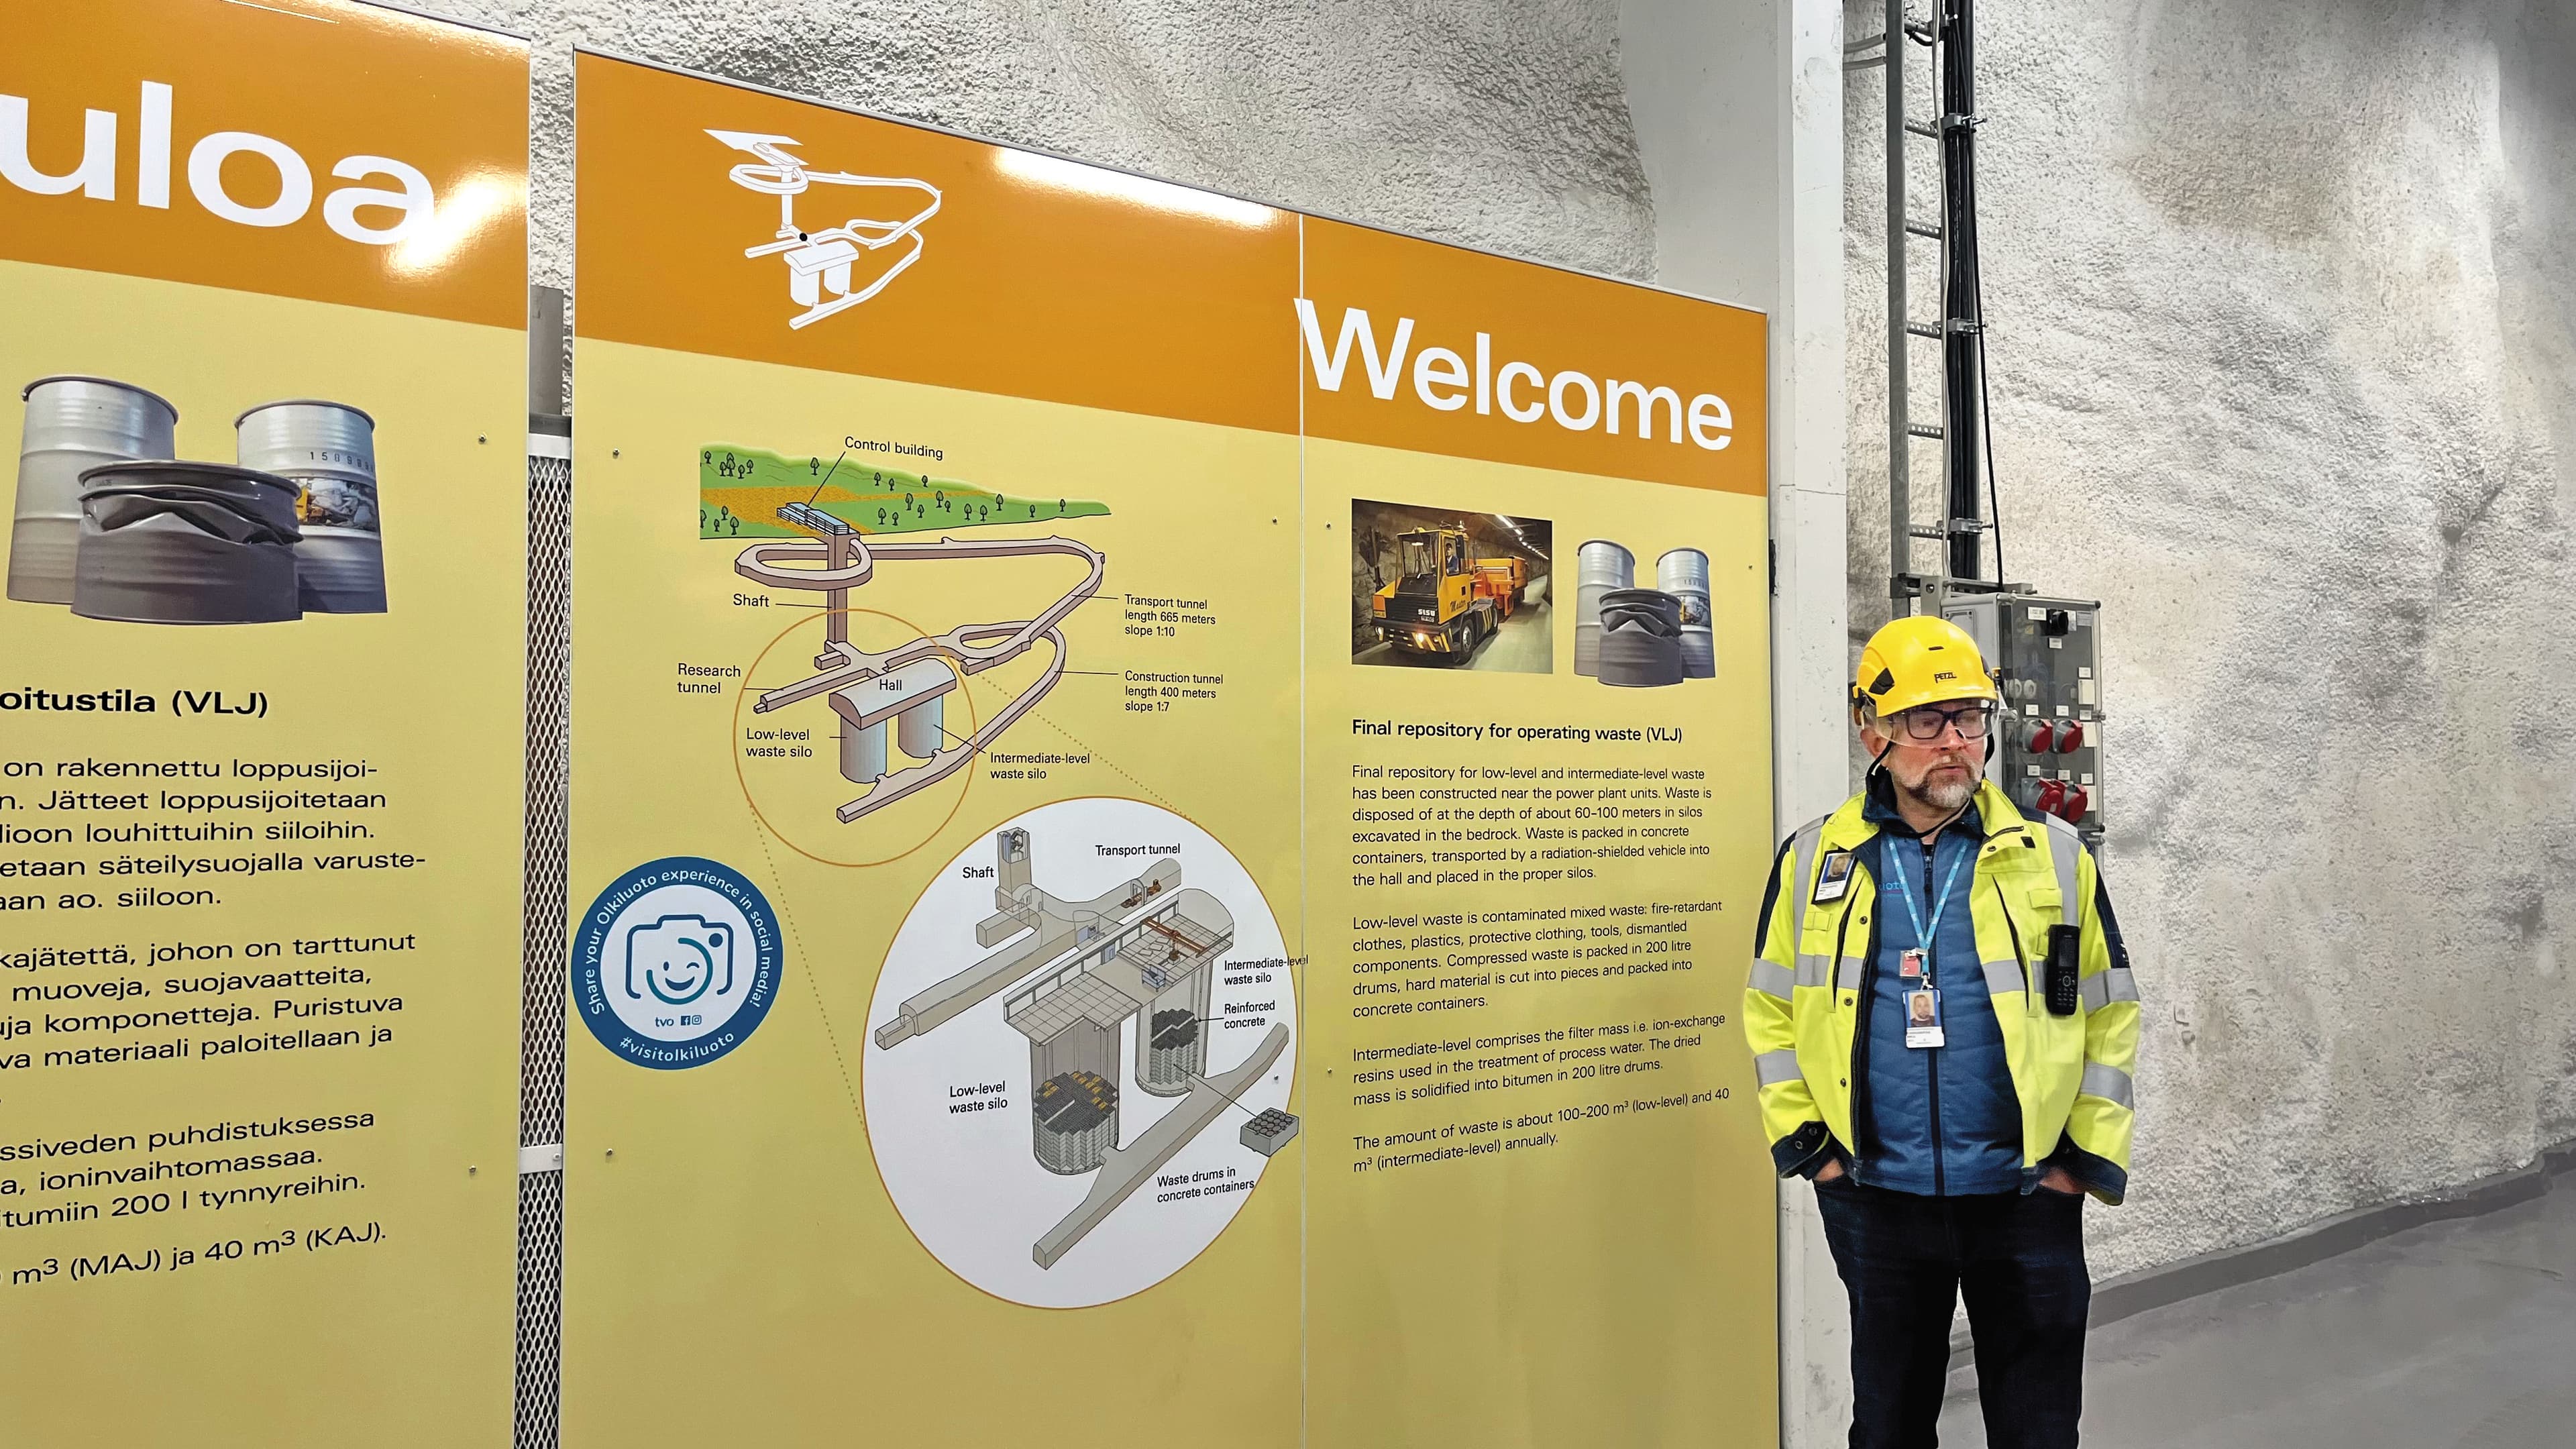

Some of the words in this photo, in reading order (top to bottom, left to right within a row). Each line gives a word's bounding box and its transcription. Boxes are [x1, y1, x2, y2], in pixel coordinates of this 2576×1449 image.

[1293, 297, 1733, 451] Welcome
[845, 436, 890, 452] Control
[896, 442, 943, 461] building
[733, 594, 769, 607] Shaft
[1124, 594, 1174, 608] Transport
[1177, 599, 1207, 609] tunnel
[1126, 609, 1157, 623] length
[1161, 612, 1178, 622] 665
[1182, 615, 1216, 625] meters
[1125, 625, 1152, 637] slope
[1157, 626, 1175, 637] 1:10
[678, 663, 741, 677] Research
[1126, 670, 1189, 683] Construction
[1193, 674, 1223, 684] tunnel
[1934, 672, 1957, 684] PETZL
[677, 682, 720, 694] tunnel
[879, 679, 902, 691] Hall
[1126, 686, 1157, 698] length
[1161, 687, 1179, 697] 400
[1183, 689, 1216, 698] meters
[0, 687, 155, 712] oitustila
[172, 690, 267, 718] (VLJ)
[1126, 700, 1152, 713] slope
[1157, 702, 1169, 711] 1:7
[747, 728, 809, 740] Low-level
[1353, 719, 1391, 735] Final
[1398, 722, 1483, 741] repository
[1489, 723, 1512, 737] for
[1517, 725, 1590, 743] operating
[1595, 728, 1642, 741] waste
[1647, 727, 1682, 743] (VLJ)
[746, 747, 786, 757] waste
[790, 745, 812, 757] silo
[991, 752, 1089, 763] Intermediate-level
[4, 763, 42, 777] on
[58, 758, 219, 777] rakennettu
[233, 759, 377, 782] loppusijoi-
[991, 769, 1024, 779] waste
[1028, 768, 1046, 779] silo
[1353, 765, 1383, 777] Final
[1389, 765, 1455, 781] repository
[1459, 766, 1477, 778] for
[1483, 767, 1536, 778] low-level
[1542, 767, 1563, 779] and
[1568, 767, 1667, 779] intermediate-level
[1672, 770, 1704, 779] waste
[38, 790, 148, 810] Jätteet
[161, 790, 385, 813] loppusijoitetaan
[1353, 787, 1377, 799] has
[1383, 787, 1414, 799] been
[1420, 787, 1497, 799] constructed
[1502, 790, 1528, 799] near
[1532, 787, 1552, 798] the
[1556, 790, 1594, 801] power
[1599, 787, 1626, 801] plant
[1631, 787, 1660, 798] units.
[1665, 787, 1699, 798] Waste
[1703, 790, 1711, 798] is
[87, 822, 252, 842] louhittuihin
[266, 821, 374, 839] siiloihin.
[1095, 845, 1146, 857] Transport
[1148, 843, 1180, 854] tunnel
[0, 859, 85, 877] etaan
[99, 853, 302, 877] säteilysuojalla
[314, 853, 425, 869] varuste-
[963, 866, 994, 878] Shaft
[661, 869, 740, 898] experience
[58, 894, 102, 908] ao.
[117, 888, 220, 907] siiloon.
[597, 874, 657, 924] Olkiluoto
[739, 894, 753, 910] in
[1354, 914, 1417, 929] Low-level
[1423, 914, 1462, 926] waste
[1468, 911, 1477, 923] is
[1483, 907, 1566, 922] contaminated
[1571, 905, 1605, 918] mixed
[1609, 905, 1647, 916] waste:
[1652, 900, 1722, 914] fire-retardant
[751, 911, 773, 952] social
[1353, 937, 1405, 951] clothes,
[1411, 934, 1464, 951] plastics,
[1470, 930, 1531, 947] protective
[1536, 927, 1586, 941] clothing,
[1591, 924, 1621, 936] tools,
[1627, 920, 1686, 934] dismantled
[147, 943, 232, 967] johon
[245, 943, 280, 957] on
[292, 934, 415, 955] tarttunut
[586, 928, 604, 965] your
[13, 977, 150, 1002] muoveja,
[164, 966, 371, 995] suojavaatteita,
[749, 955, 771, 1008] media!
[1224, 975, 1252, 985] waste
[1256, 972, 1271, 983] silo
[586, 969, 604, 1015] Share
[1225, 1000, 1275, 1014] Reinforced
[1354, 1002, 1412, 1017] concrete
[1417, 996, 1488, 1012] containers.
[0, 1016, 31, 1040] ja
[46, 1003, 259, 1034] komponetteja.
[274, 998, 402, 1018] Puristuva
[655, 1016, 674, 1027] tvo
[1224, 1017, 1265, 1029] concrete
[45, 1038, 188, 1066] materiaali
[202, 1030, 359, 1060] paloitellaan
[368, 1025, 391, 1046] ja
[619, 1032, 735, 1062] #visitolkiluoto
[1354, 1037, 1470, 1061] Intermediate-level
[1476, 1032, 1540, 1049] comprises
[1544, 1029, 1564, 1041] the
[1568, 1026, 1594, 1039] filter
[1599, 1025, 1629, 1036] mass
[1633, 1021, 1648, 1032] i.e.
[1654, 1015, 1725, 1030] ion-exchange
[950, 1081, 1005, 1097] Low-level
[949, 1101, 984, 1114] waste
[988, 1097, 1008, 1109] silo
[149, 1114, 374, 1152] puhdistuksessa
[1378, 1139, 1500, 1171] (intermediate-level)
[1505, 1132, 1558, 1150] annually.
[1, 1180, 25, 1195] a,
[40, 1150, 321, 1191] ioninvaihtomassaa.
[1157, 1175, 1189, 1187] Waste
[1192, 1171, 1224, 1182] drums
[1227, 1167, 1235, 1177] in
[0, 1201, 97, 1227] tumiin
[111, 1193, 170, 1216] 200
[199, 1174, 364, 1210] tynnyreihin.
[1157, 1188, 1201, 1203] concrete
[1204, 1181, 1254, 1195] containers
[71, 1249, 160, 1281] (MAJ)
[170, 1247, 194, 1271] ja
[205, 1240, 242, 1260] 40
[307, 1222, 385, 1251] (KAJ).
